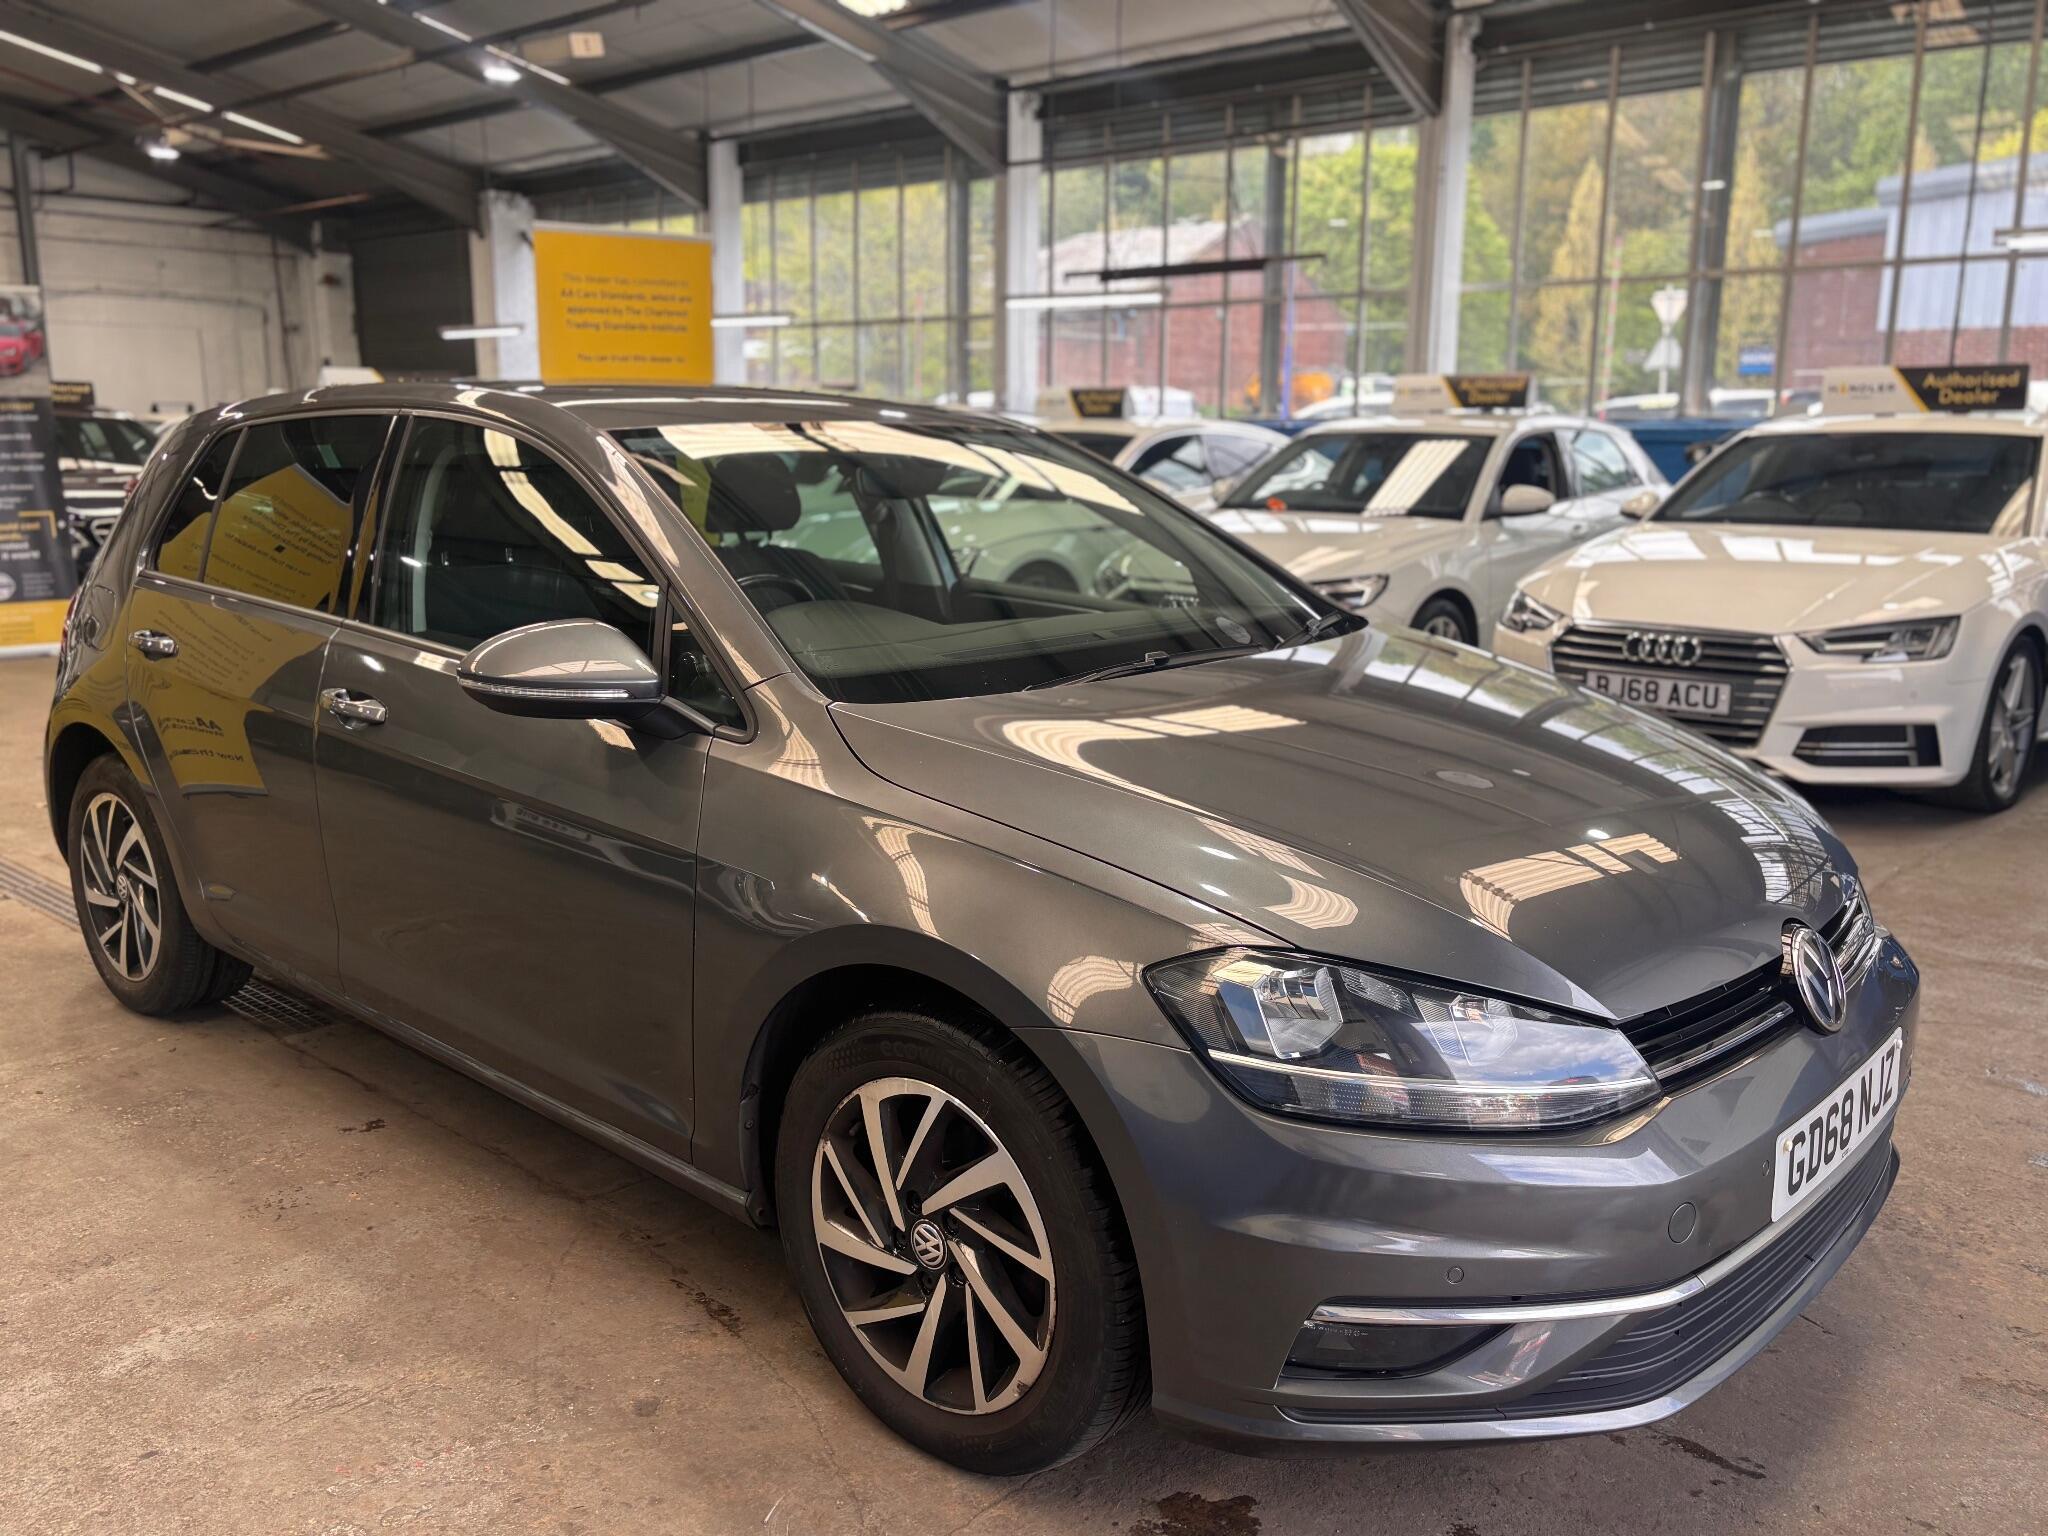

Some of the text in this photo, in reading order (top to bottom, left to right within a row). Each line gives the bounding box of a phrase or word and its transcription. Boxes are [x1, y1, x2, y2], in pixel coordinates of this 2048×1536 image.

[1922, 371, 2020, 389] Authorised
[1938, 388, 2000, 405] Dealer
[1668, 682, 1720, 710] ACU
[1786, 1047, 1897, 1197] GD68 NJZ
